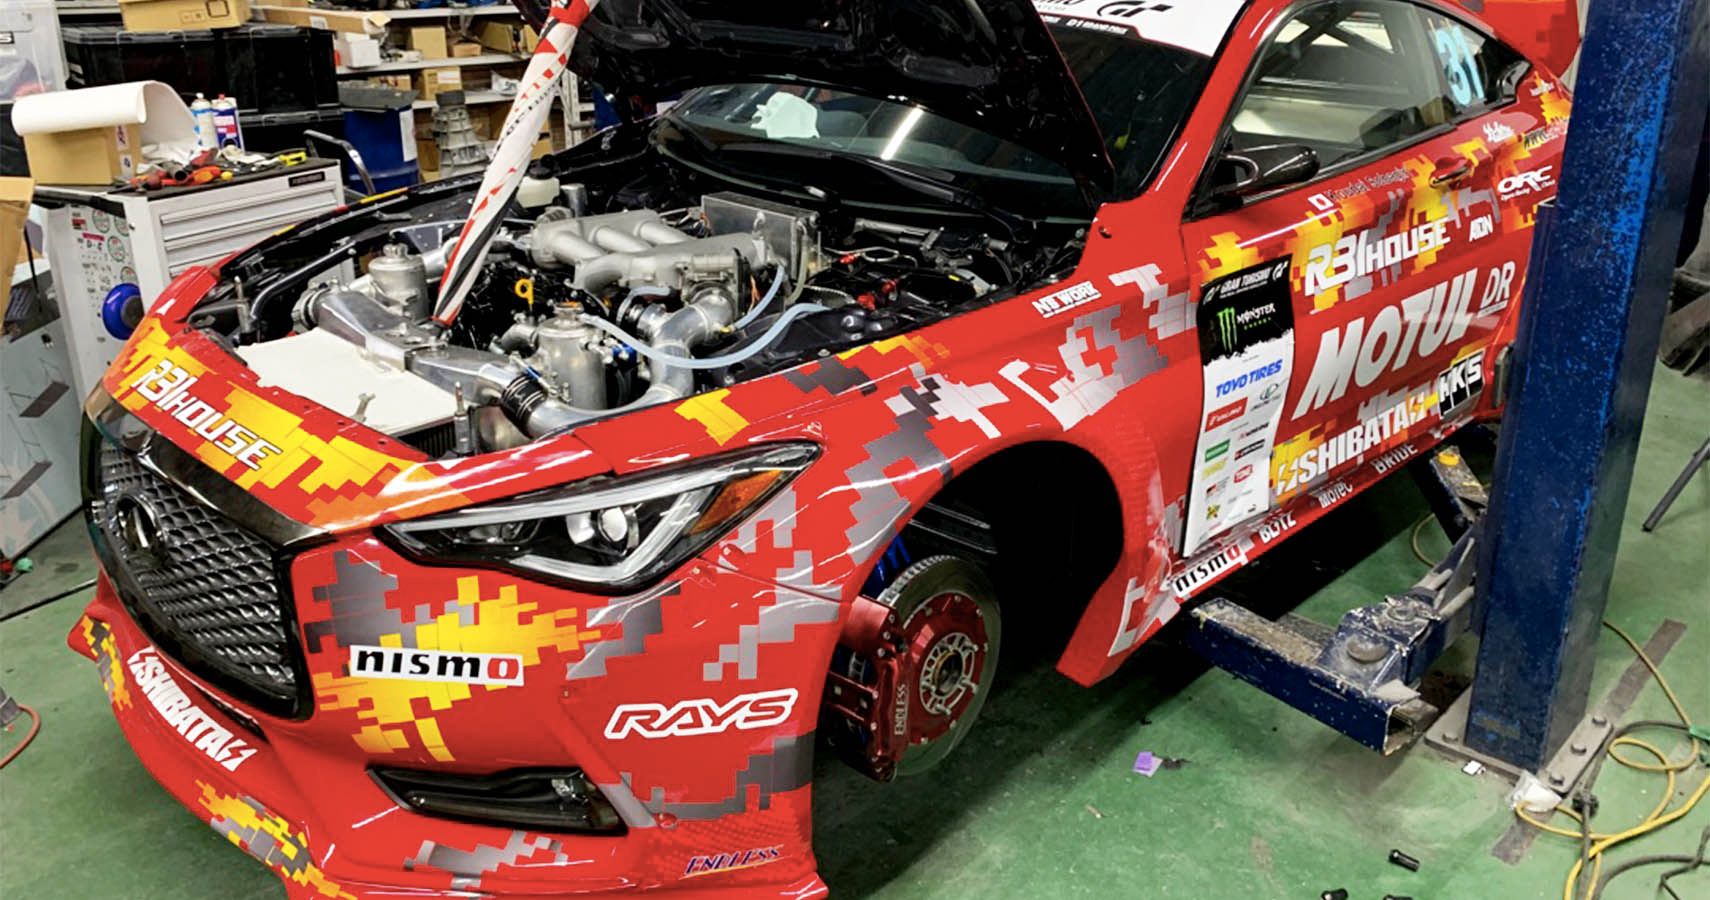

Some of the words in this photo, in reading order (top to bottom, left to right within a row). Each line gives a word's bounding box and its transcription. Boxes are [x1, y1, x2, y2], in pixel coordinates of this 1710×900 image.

[1435, 25, 1485, 105] 31
[1236, 303, 1276, 324] MONSTER
[1291, 268, 1478, 421] MOTUL
[1480, 261, 1515, 308] DR
[1216, 374, 1248, 398] TOYO
[1248, 358, 1283, 384] TIRES
[1439, 353, 1482, 402] HKS
[1298, 404, 1411, 484] SHIBATA
[356, 650, 520, 680] nismo
[135, 657, 234, 759] SHIBATA
[604, 688, 799, 739] RAYS
[894, 683, 906, 736] ENDLESS
[685, 848, 780, 876] ENDLESS
